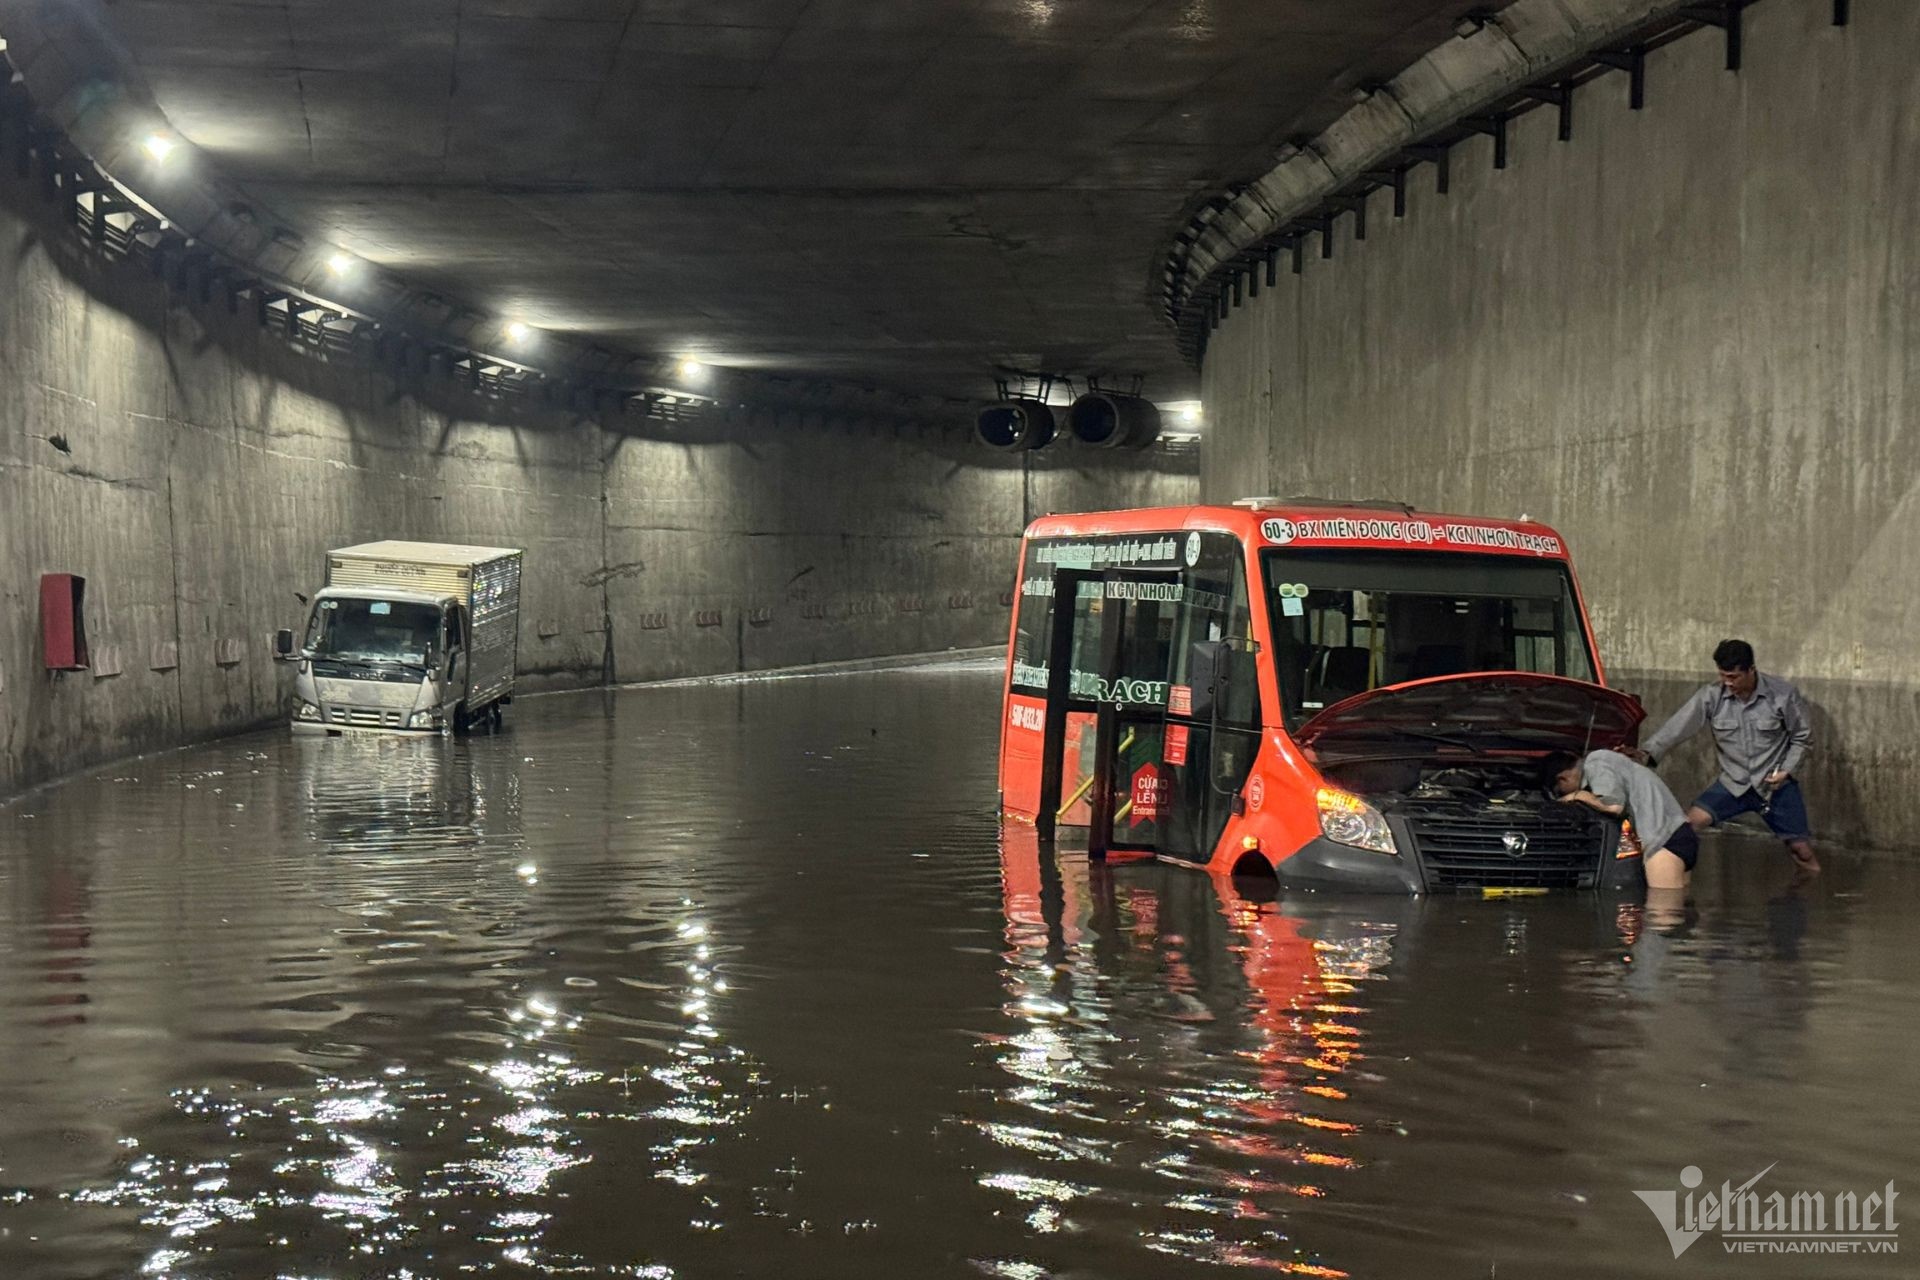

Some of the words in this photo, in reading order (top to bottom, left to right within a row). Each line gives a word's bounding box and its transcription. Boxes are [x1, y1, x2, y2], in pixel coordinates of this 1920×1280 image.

[1263, 521, 1294, 539] 60-3
[1297, 520, 1319, 538] BX
[1446, 524, 1474, 544] KCN
[1106, 581, 1136, 599] KCN
